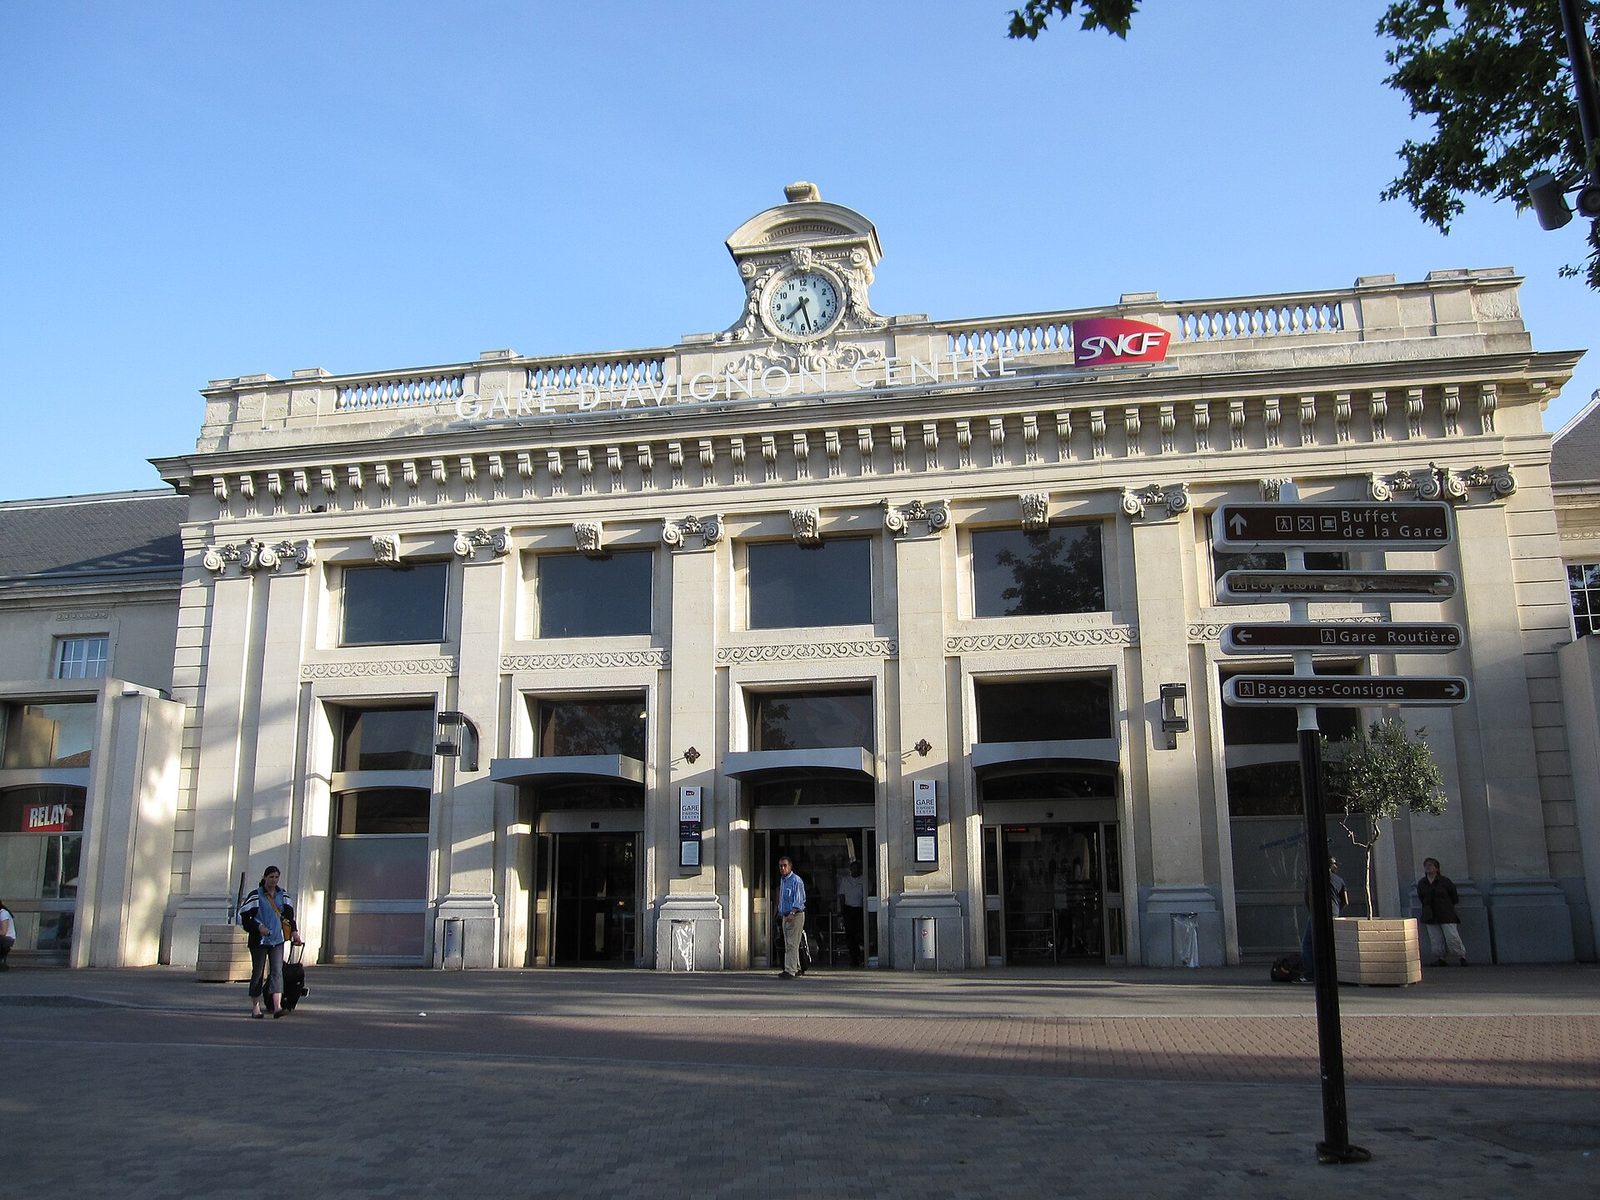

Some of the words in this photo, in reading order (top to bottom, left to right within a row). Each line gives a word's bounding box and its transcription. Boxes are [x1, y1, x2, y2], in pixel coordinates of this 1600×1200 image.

[1078, 332, 1165, 361] SNCF
[455, 383, 557, 419] GARE
[578, 360, 827, 410] D'AVIGNON
[852, 346, 1017, 388] CENTRE
[1341, 510, 1398, 522] Buffet
[1343, 524, 1365, 537] de
[1374, 524, 1390, 537] la
[1400, 525, 1442, 537] Gare
[1339, 632, 1376, 642] Gare
[1388, 630, 1456, 642] Routière
[1258, 683, 1405, 697] Bagages-Consigne
[29, 804, 67, 828] RELAY
